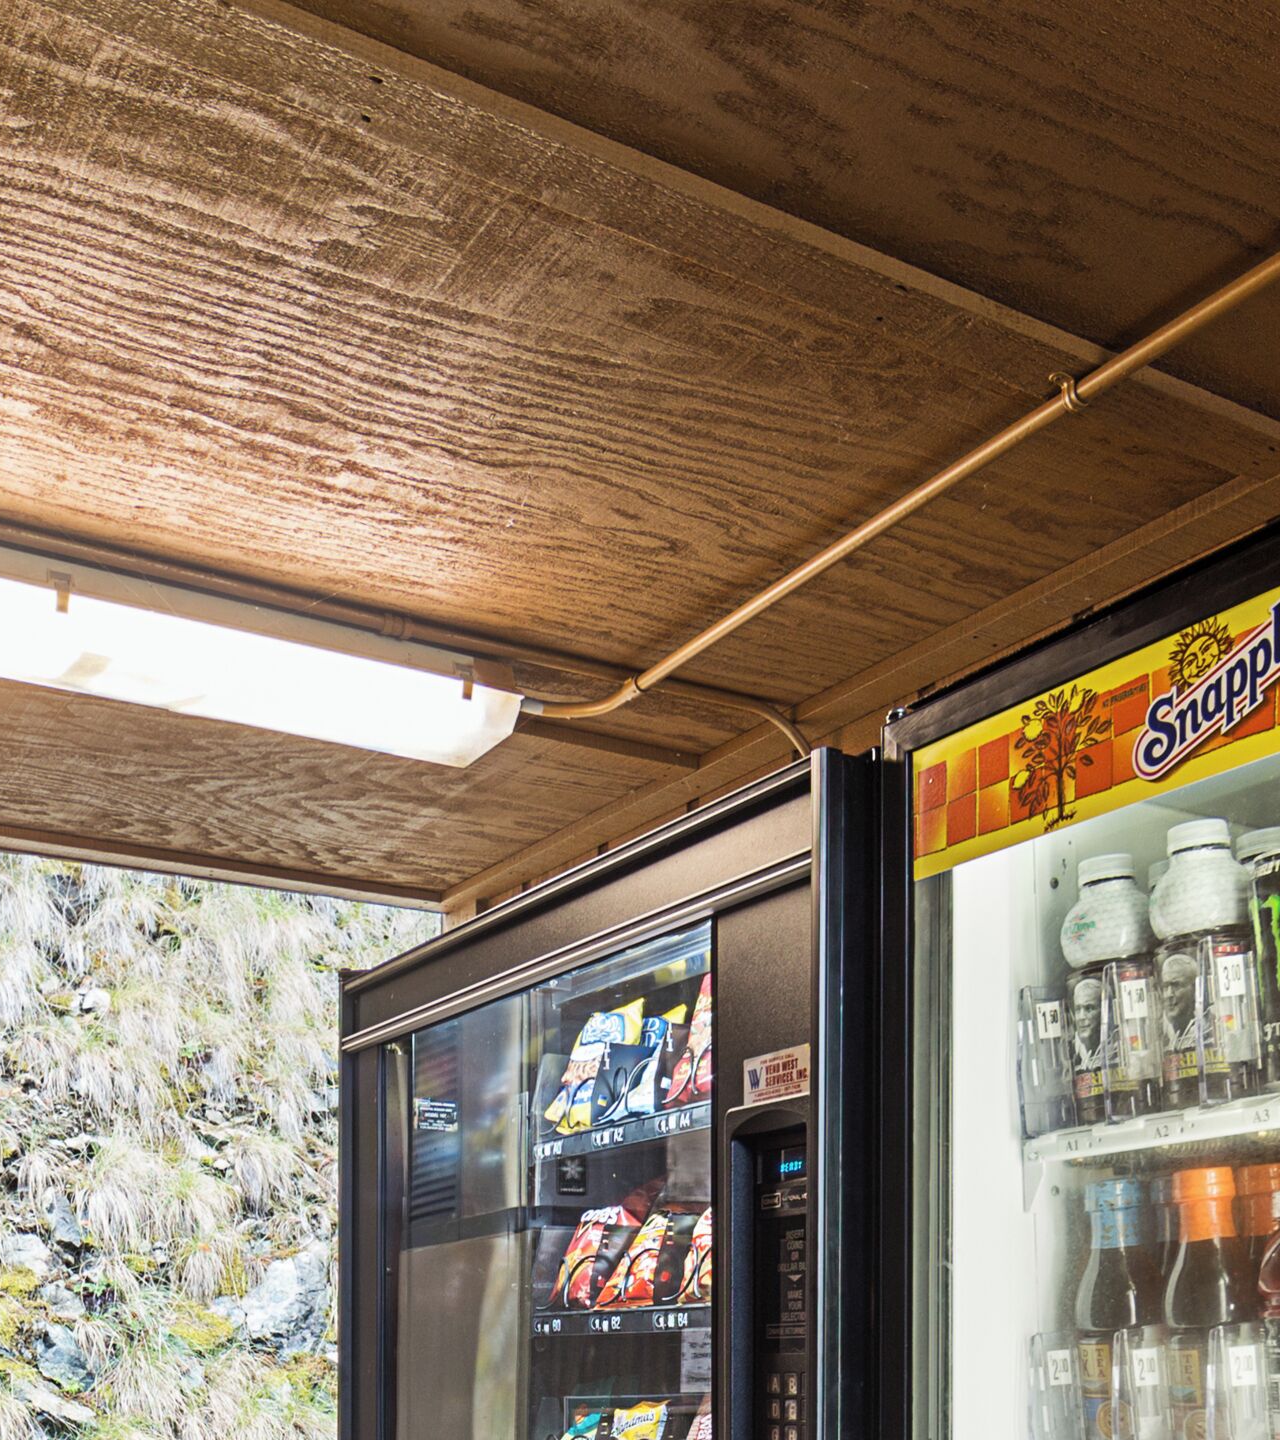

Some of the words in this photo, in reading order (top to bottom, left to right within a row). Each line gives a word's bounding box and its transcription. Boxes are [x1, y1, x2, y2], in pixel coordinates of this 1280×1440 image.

[765, 1062, 780, 1076] VEND
[782, 1058, 799, 1072] WEST
[1253, 1109, 1270, 1124] A3
[1154, 1125, 1169, 1139] A2
[1065, 1139, 1079, 1152] A1
